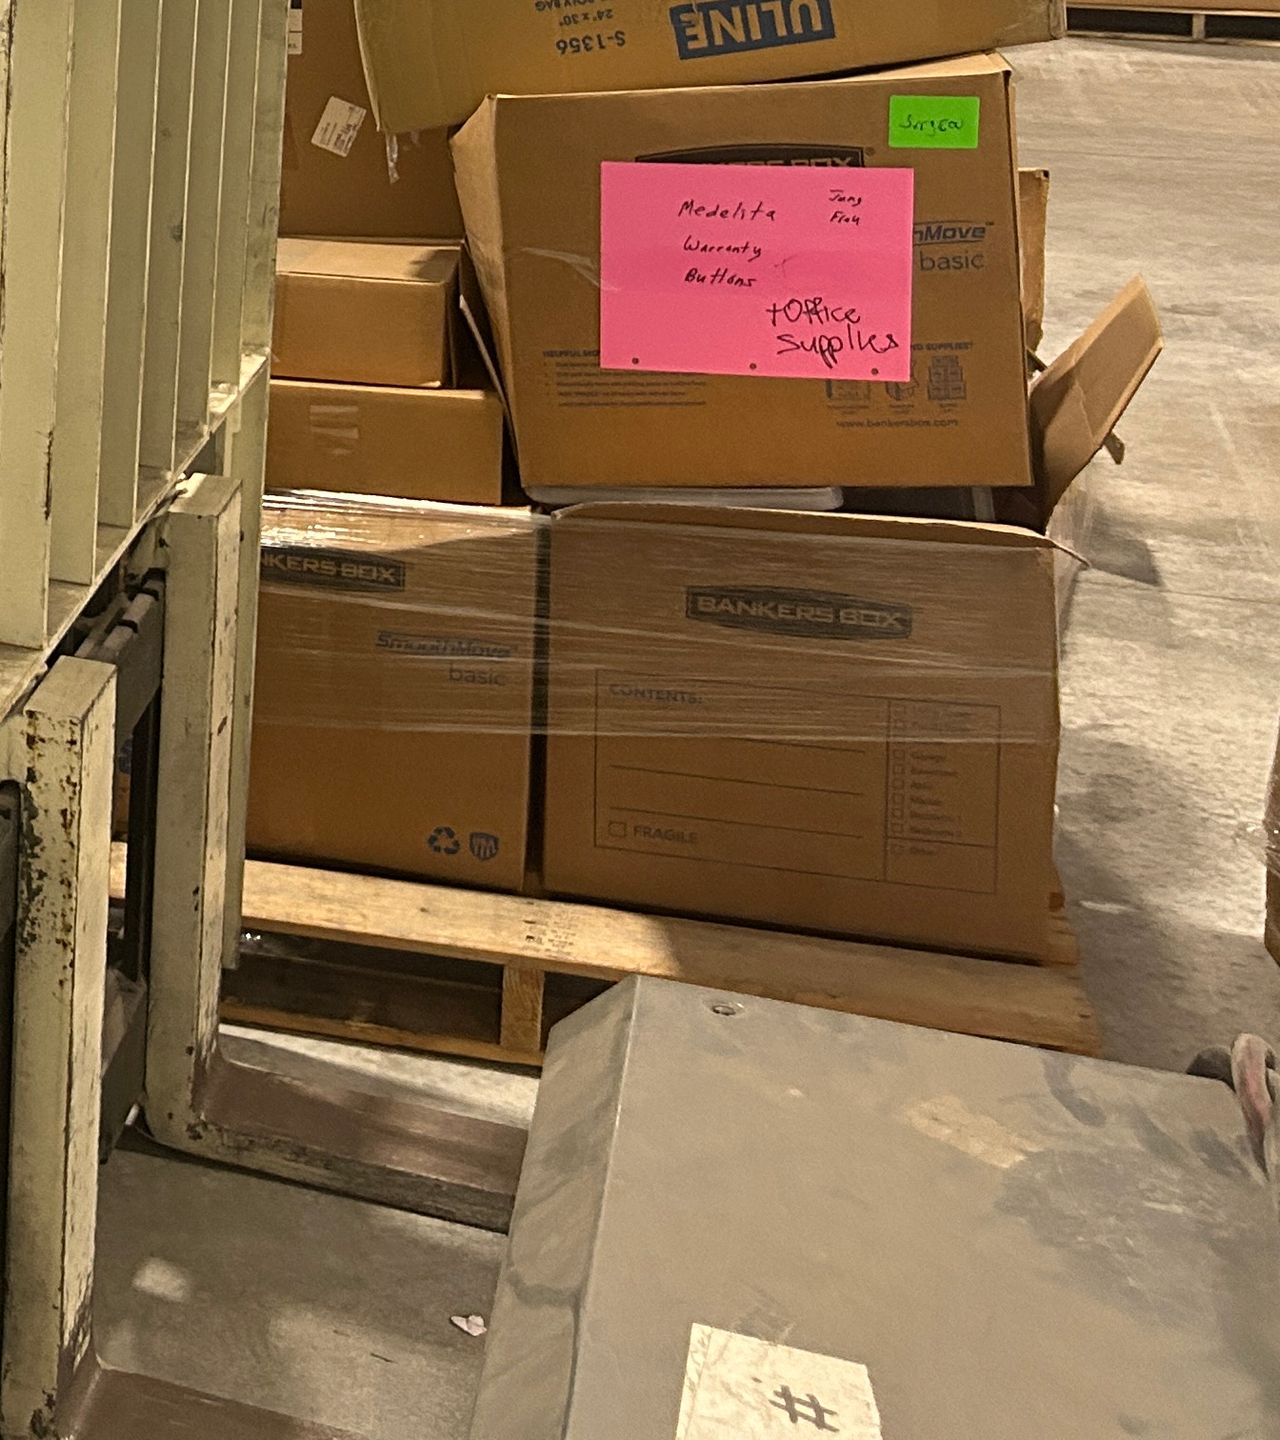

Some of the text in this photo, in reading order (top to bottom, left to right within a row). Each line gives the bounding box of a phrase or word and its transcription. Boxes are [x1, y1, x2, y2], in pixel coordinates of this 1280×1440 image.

[555, 29, 627, 56] S-1356
[683, 234, 763, 263] Warranty
[919, 250, 986, 272] basic
[684, 267, 757, 288] Buttons
[341, 564, 396, 583] BOX
[696, 595, 904, 629] BANKERS BOX
[448, 664, 507, 687] basic
[633, 824, 698, 844] FRAGILE
[767, 1384, 841, 1433] #
